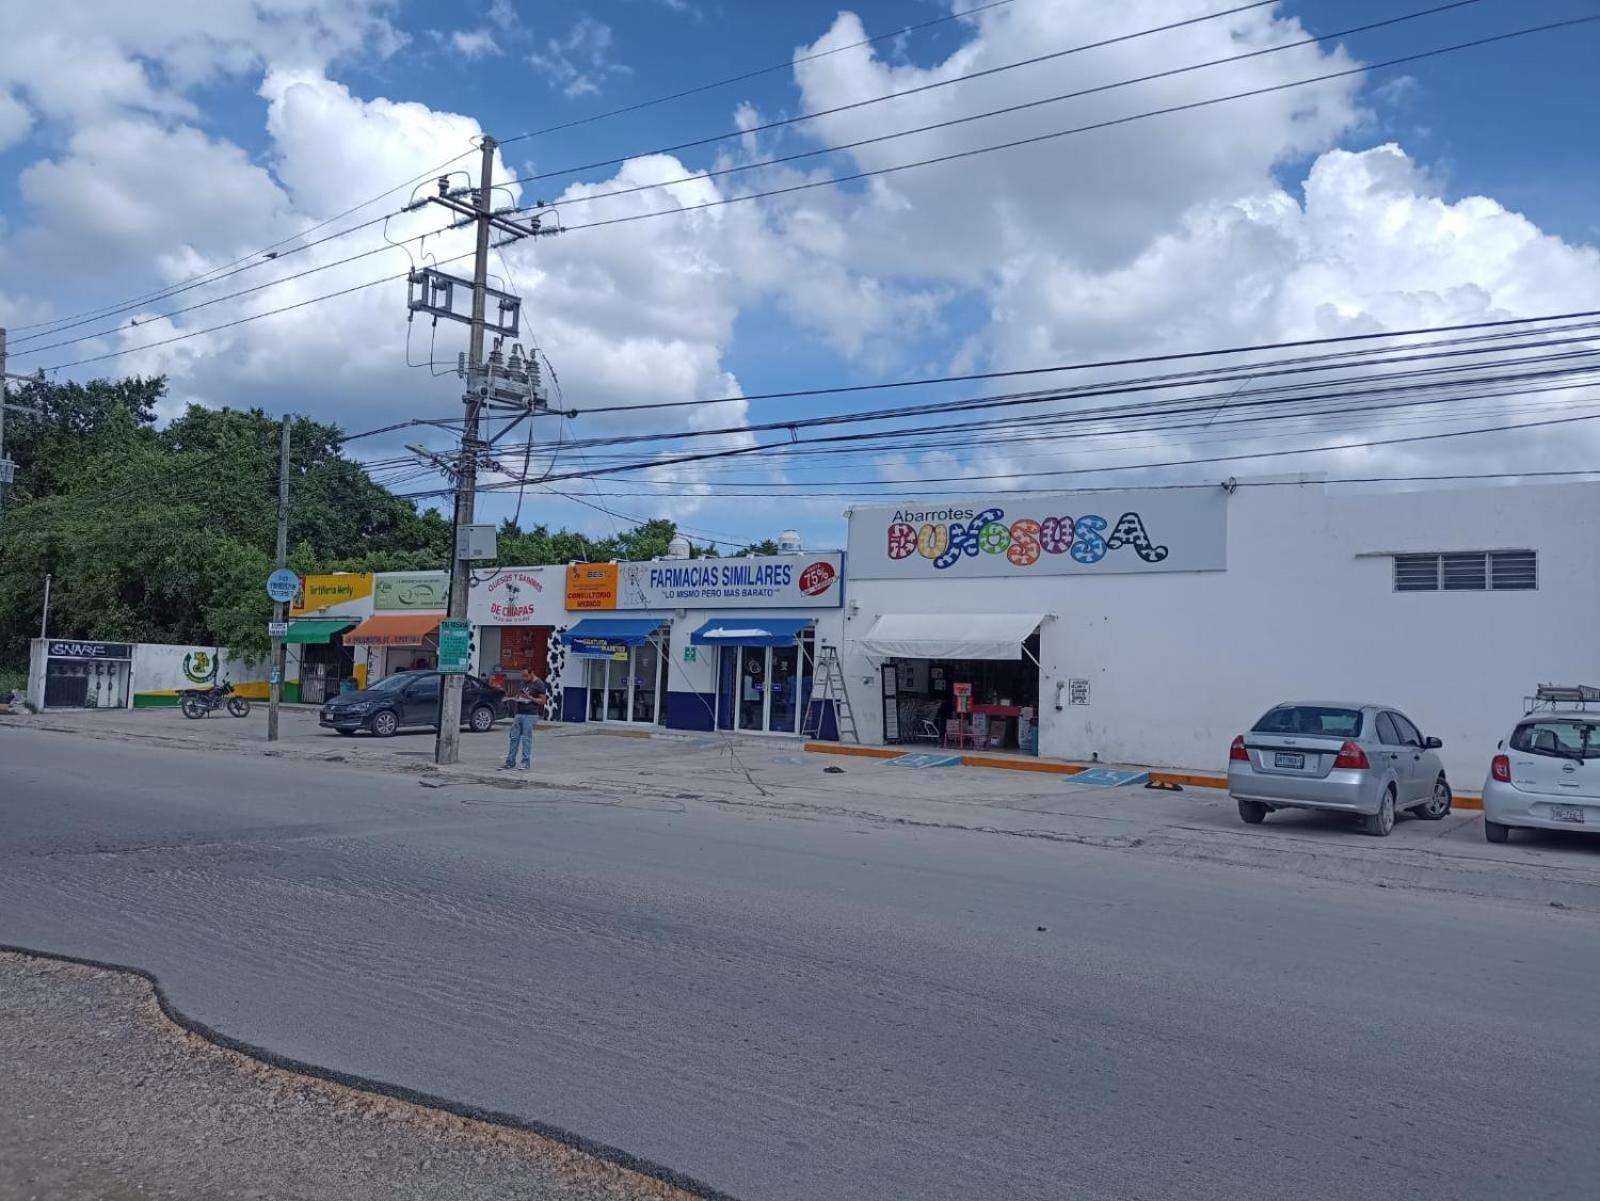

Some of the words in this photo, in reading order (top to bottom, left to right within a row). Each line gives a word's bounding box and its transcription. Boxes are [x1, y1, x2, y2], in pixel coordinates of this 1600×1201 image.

[892, 508, 974, 523] Abarrotes
[650, 567, 718, 588] FARMACIAS
[722, 565, 791, 586] SIMILARES
[803, 568, 829, 589] 75%
[676, 590, 700, 598] MISMO
[701, 590, 722, 598] PERO
[490, 603, 502, 615] DE
[502, 604, 535, 617] CHIAPAS
